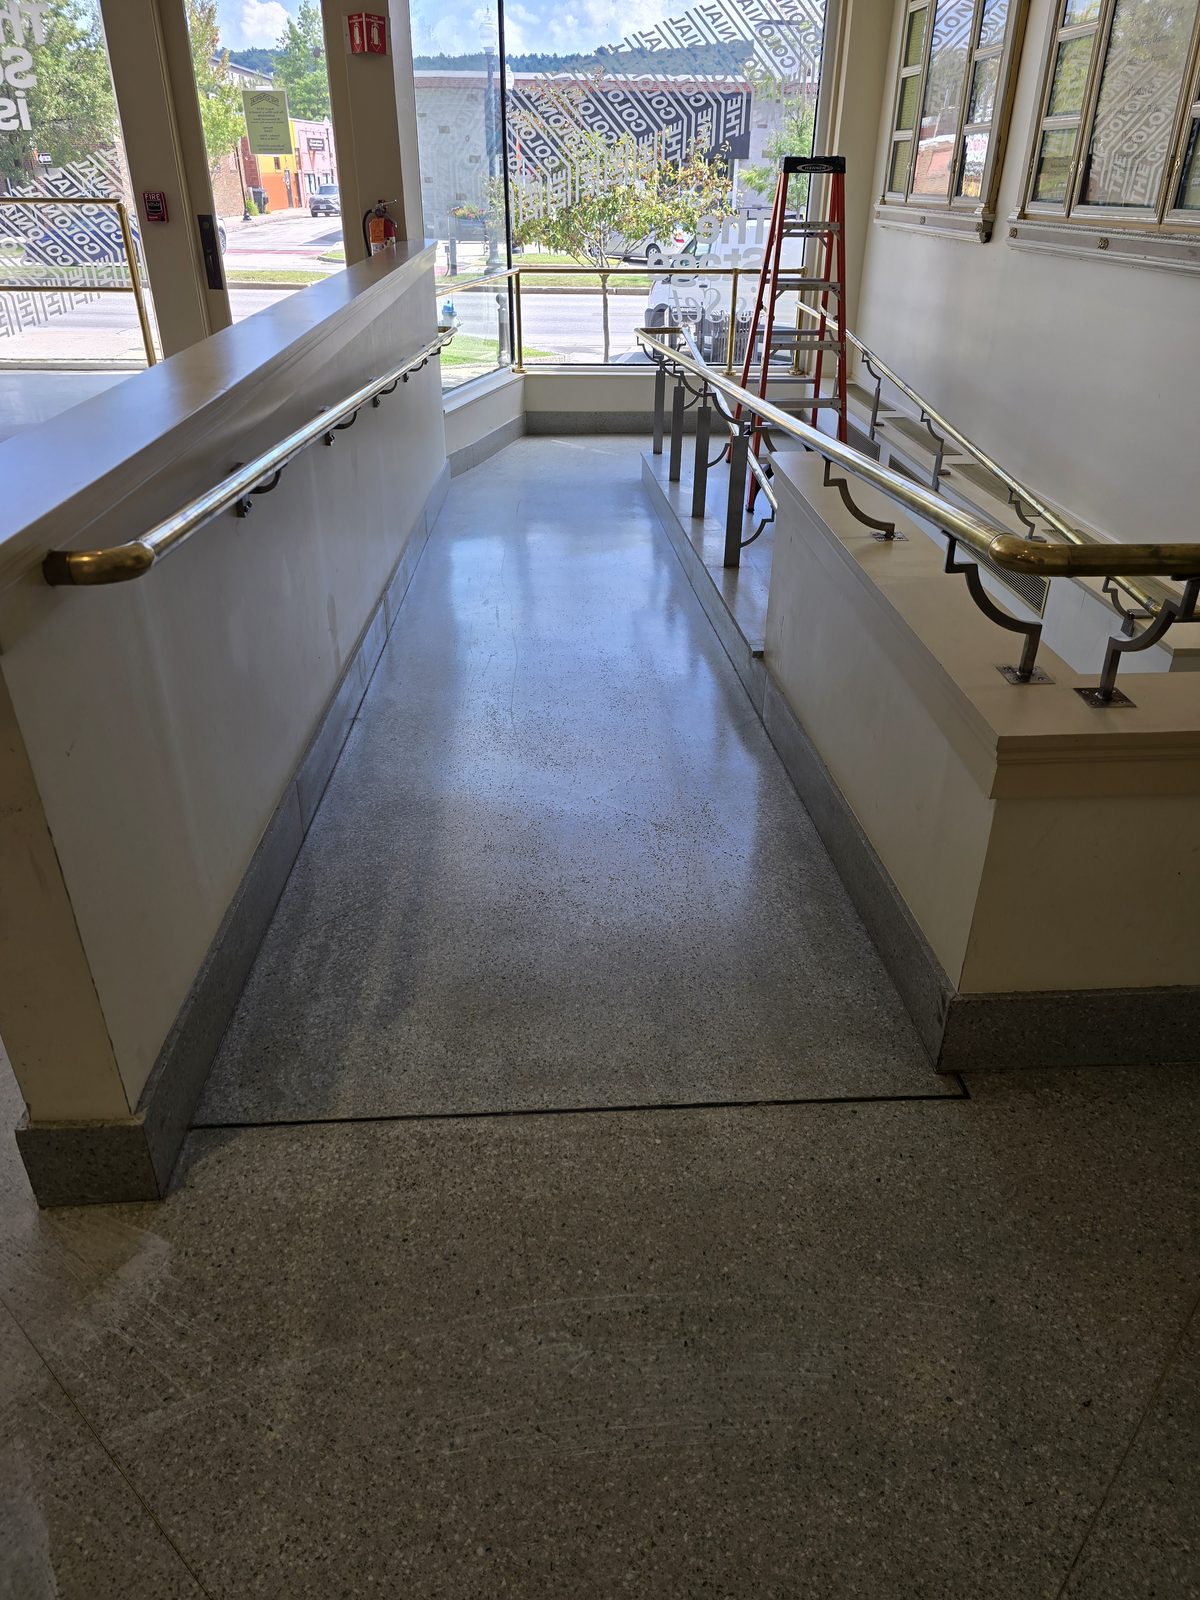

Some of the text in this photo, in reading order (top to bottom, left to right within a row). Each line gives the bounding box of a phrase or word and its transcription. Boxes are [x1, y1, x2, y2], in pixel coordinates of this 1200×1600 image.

[1110, 154, 1128, 193] THE
[1132, 163, 1151, 201] THE
[144, 193, 161, 201] FIRE
